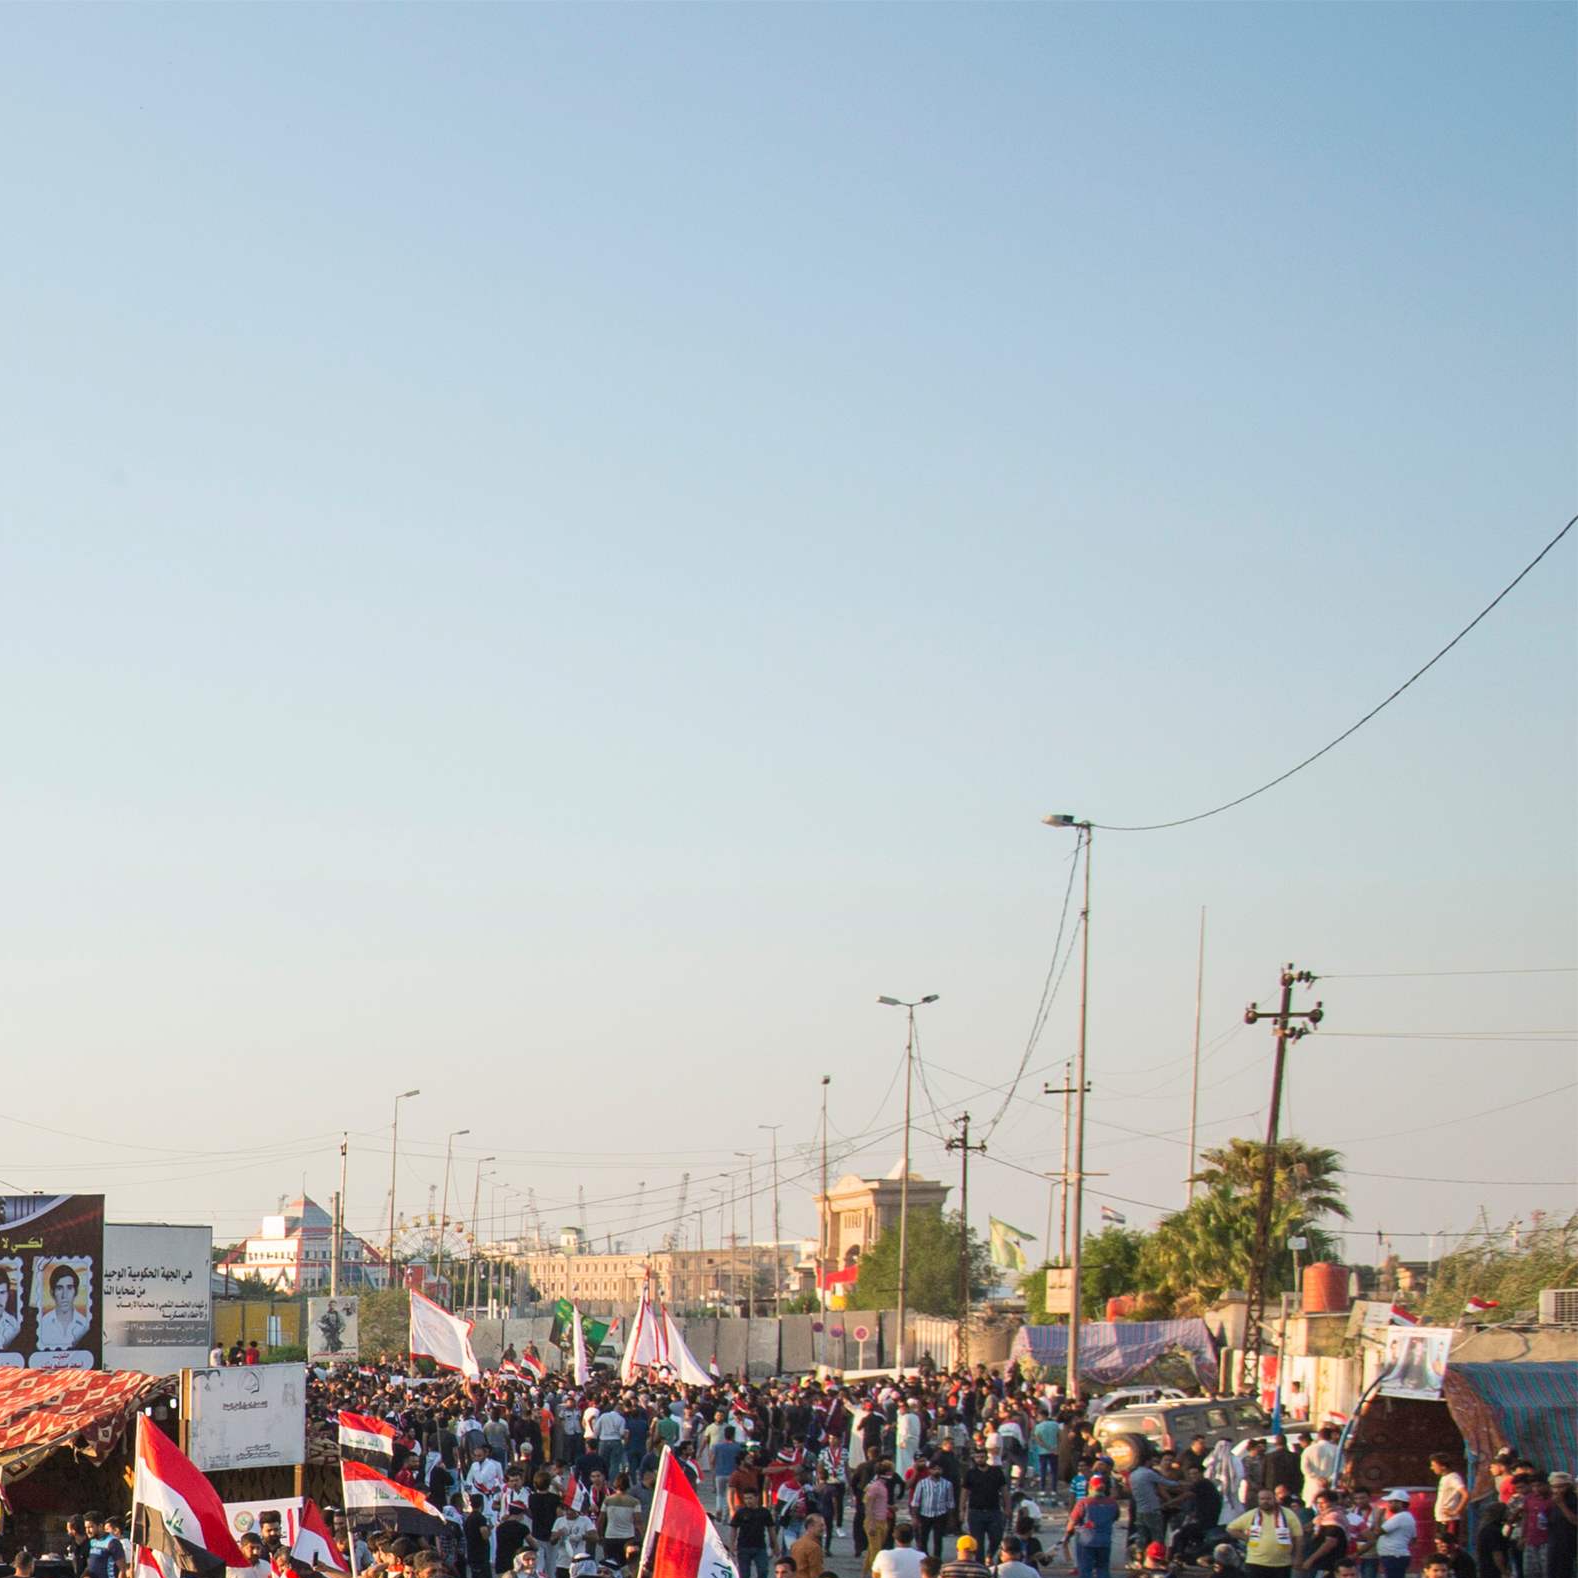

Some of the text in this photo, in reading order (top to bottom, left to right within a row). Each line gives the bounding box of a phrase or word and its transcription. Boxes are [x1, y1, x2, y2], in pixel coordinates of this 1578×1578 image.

[1, 1237, 9, 1249] لا
[11, 1236, 44, 1252] لكي
[104, 1266, 193, 1285] هي الجهة الحكومية الوحيد
